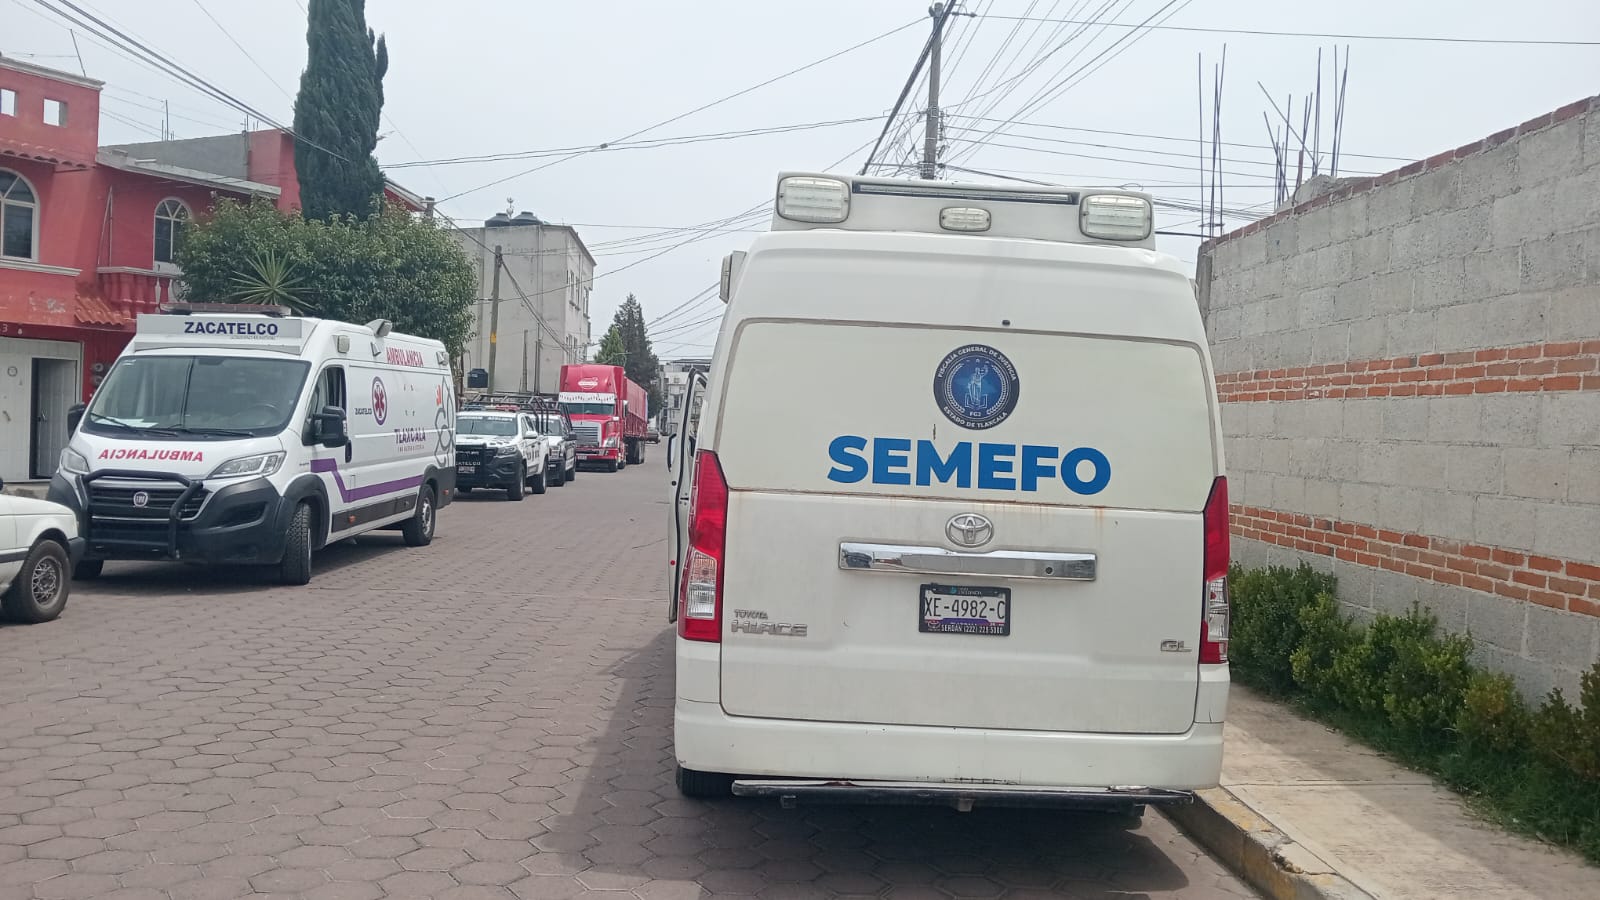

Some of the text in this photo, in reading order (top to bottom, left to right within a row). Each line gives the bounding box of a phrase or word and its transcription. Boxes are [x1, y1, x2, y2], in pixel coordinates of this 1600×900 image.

[184, 321, 278, 336] ZACATELCO
[386, 346, 424, 368] AMBULANCIA
[958, 346, 988, 355] GENERAL
[989, 349, 997, 357] DE
[998, 354, 1017, 381] JUSTICIA
[943, 406, 965, 425] ESTADO
[976, 411, 1008, 428] TLAXCALA
[827, 435, 1111, 495] SEMEFO
[925, 597, 1005, 620] XE-4982-C
